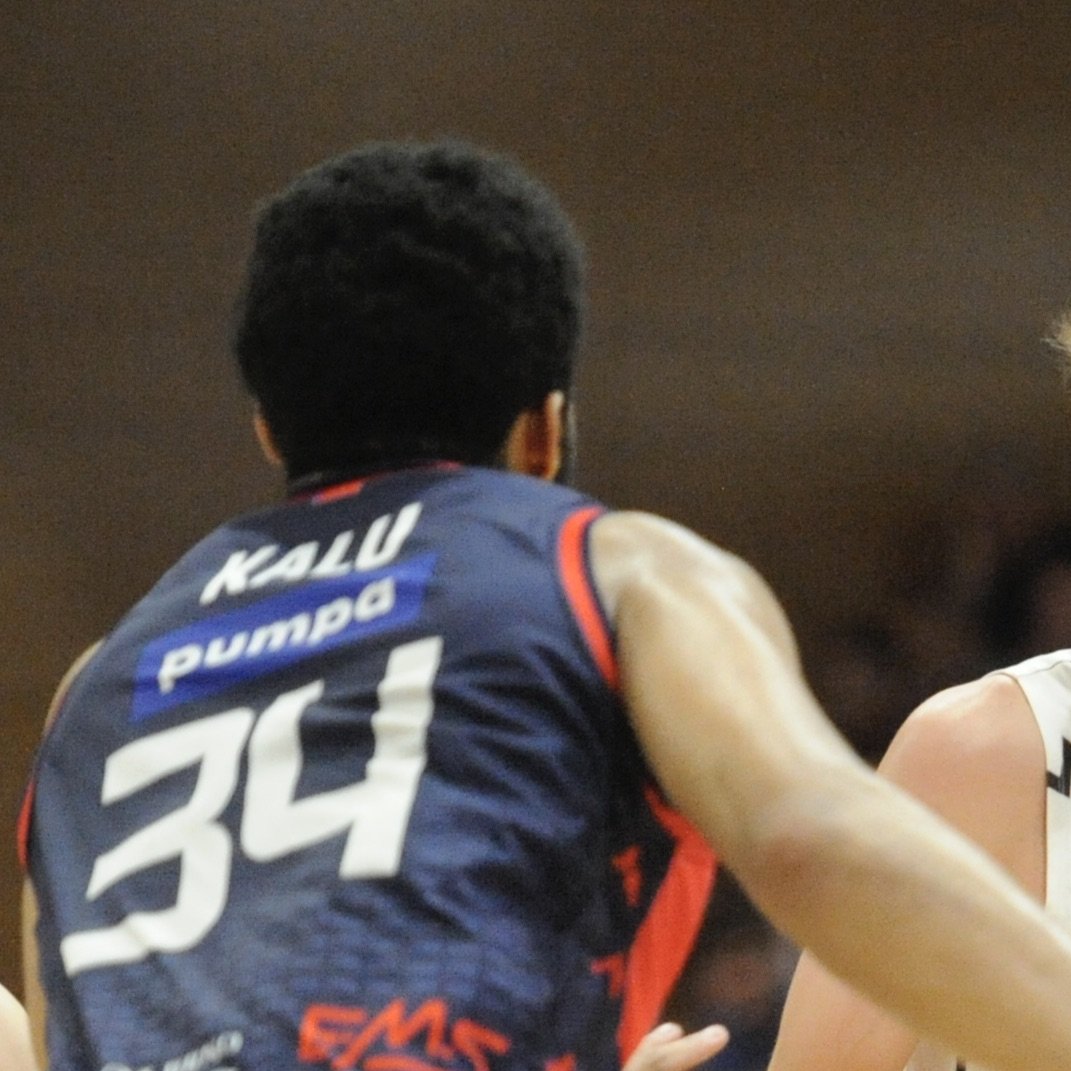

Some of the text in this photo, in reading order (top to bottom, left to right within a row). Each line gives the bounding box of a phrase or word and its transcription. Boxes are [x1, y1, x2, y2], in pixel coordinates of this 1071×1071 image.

[200, 501, 423, 605] KALU
[158, 576, 397, 695] pumpa
[61, 636, 443, 978] 34
